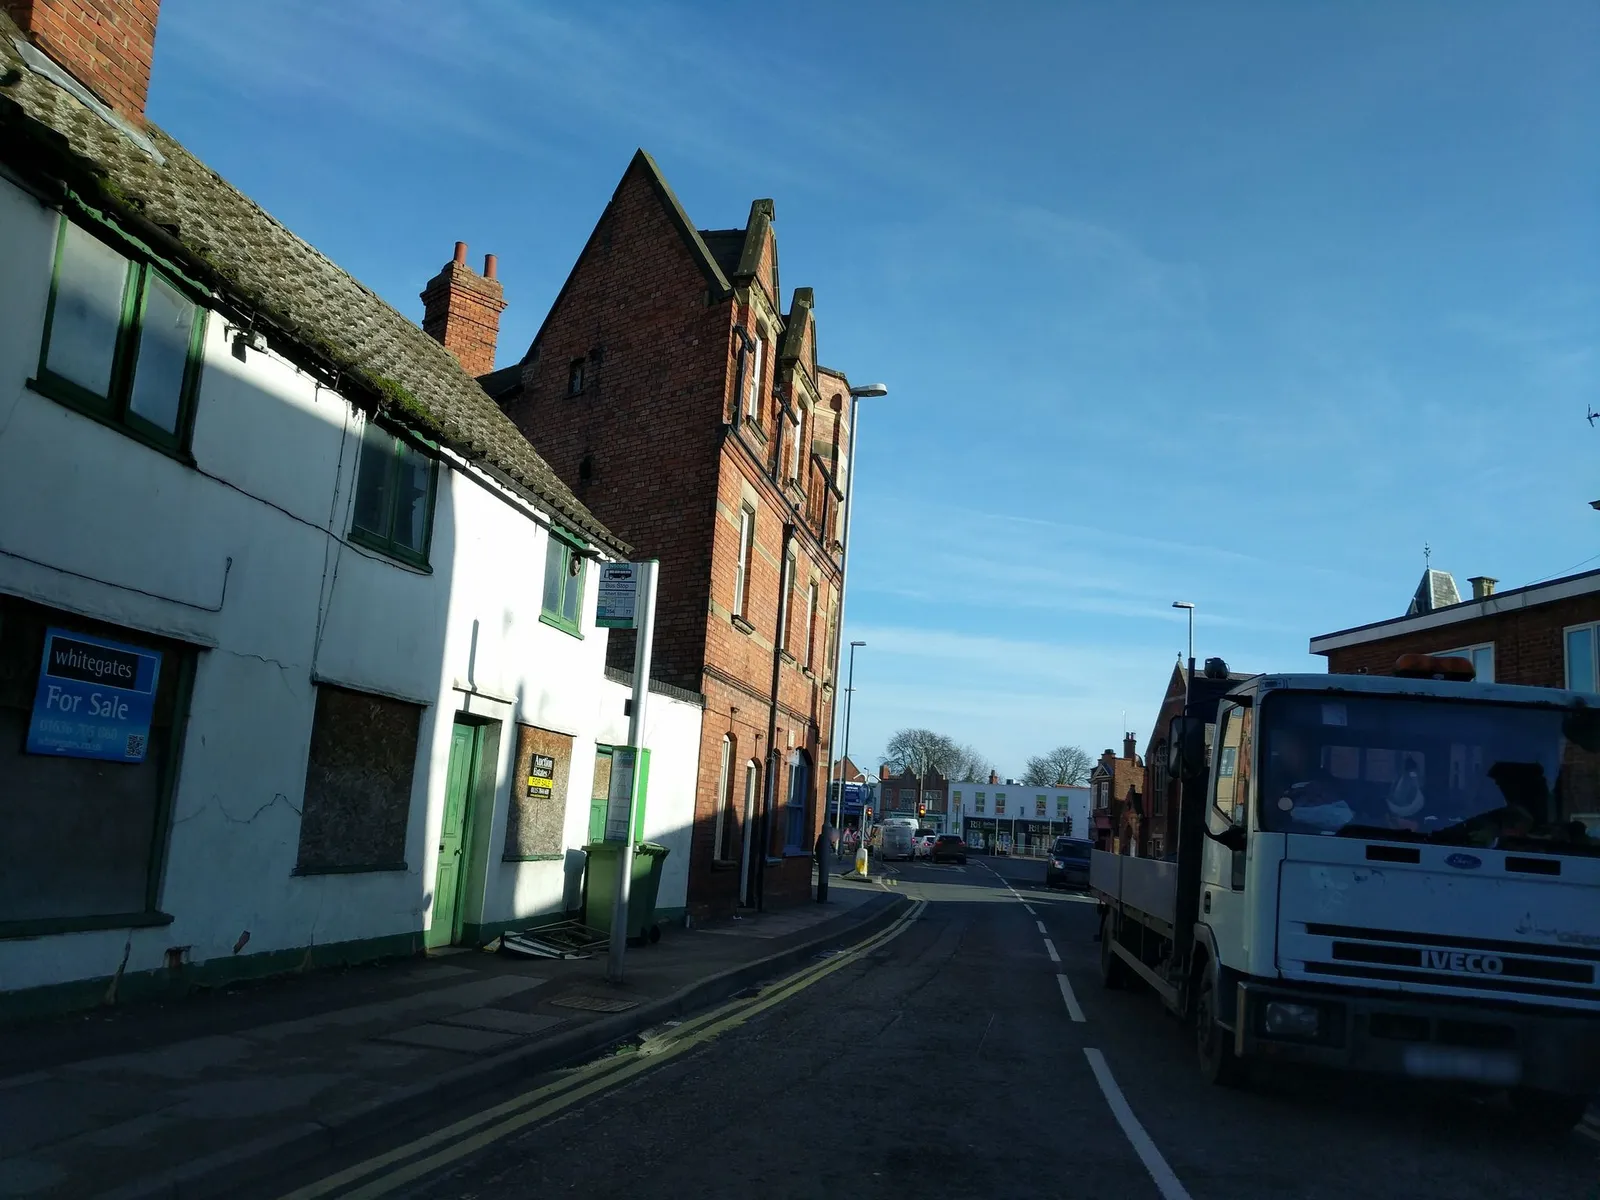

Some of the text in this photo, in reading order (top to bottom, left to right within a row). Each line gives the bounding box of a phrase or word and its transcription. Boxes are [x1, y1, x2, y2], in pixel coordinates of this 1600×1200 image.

[55, 649, 132, 678] whitegates
[46, 685, 129, 720] For Sale
[1421, 951, 1503, 974] IVECO
